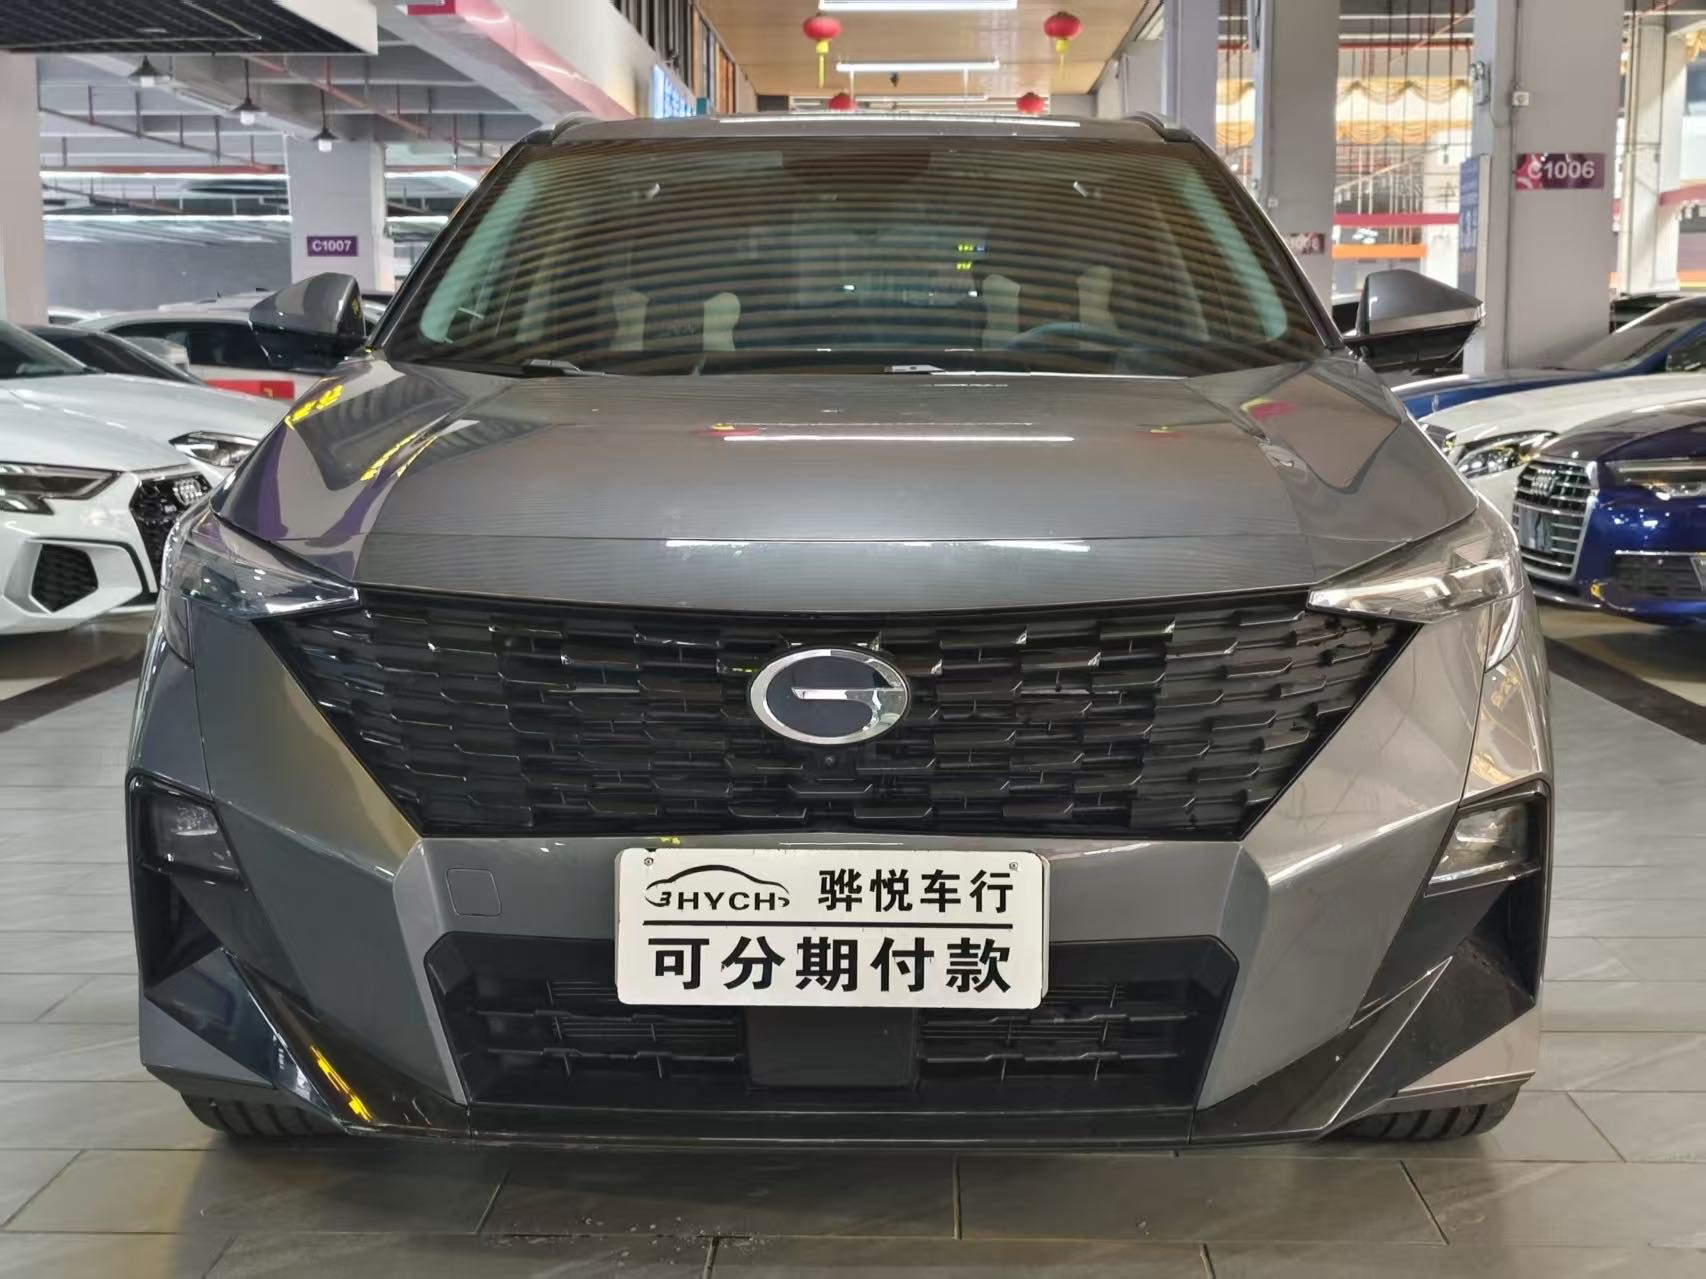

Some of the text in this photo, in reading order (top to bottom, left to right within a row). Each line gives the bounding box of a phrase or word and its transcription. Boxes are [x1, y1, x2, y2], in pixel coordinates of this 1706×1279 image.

[1527, 160, 1595, 180] C1006
[312, 240, 352, 251] C1007
[818, 868, 1014, 914] 骅悦车行
[648, 935, 1011, 993] 可分期付款
